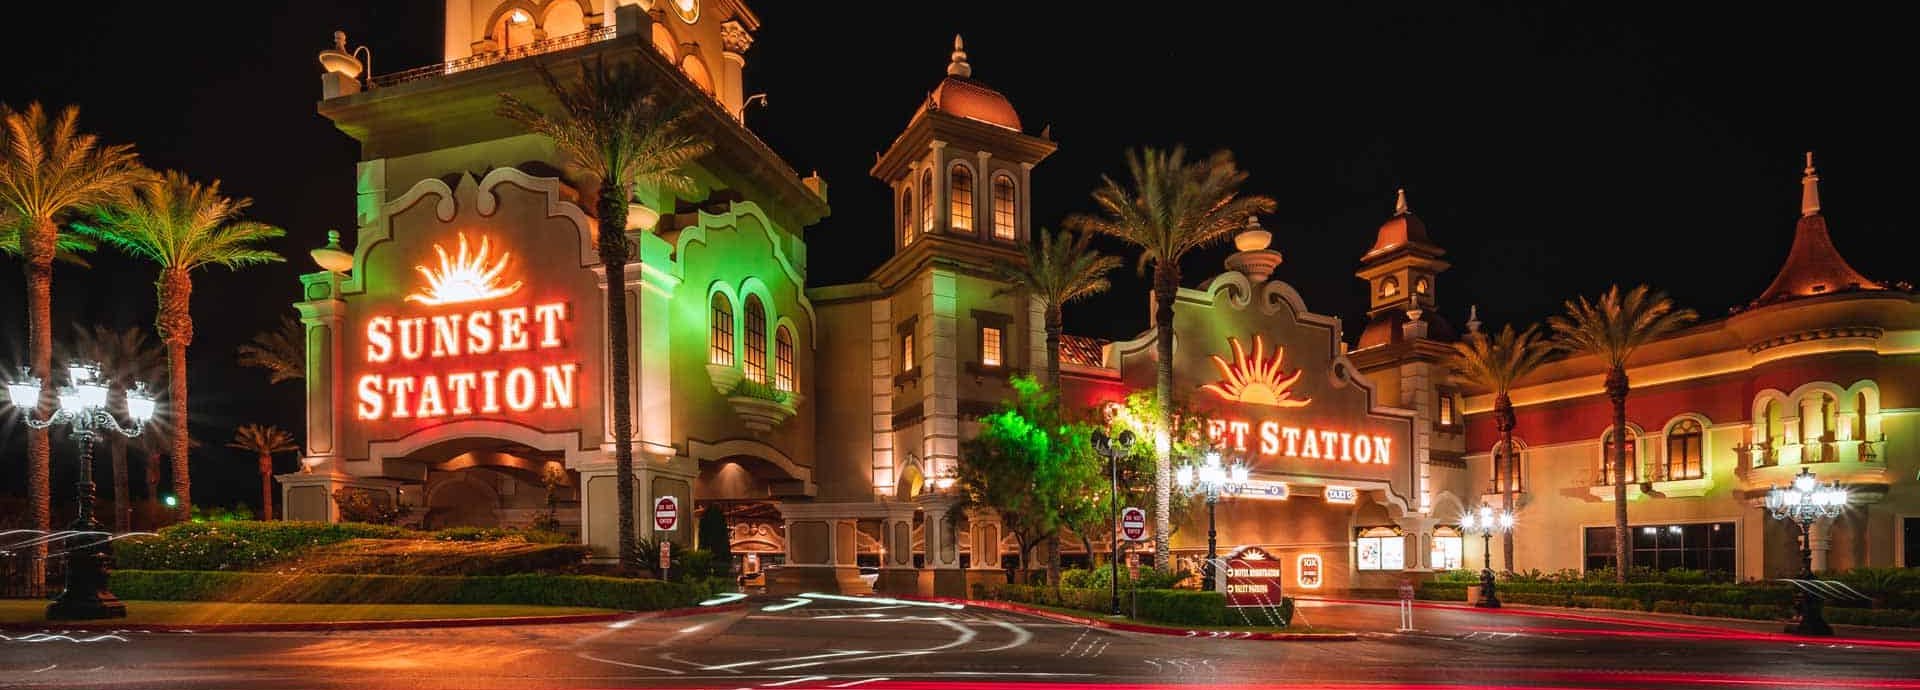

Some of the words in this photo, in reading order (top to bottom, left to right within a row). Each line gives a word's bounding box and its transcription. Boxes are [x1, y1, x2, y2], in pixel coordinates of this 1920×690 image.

[366, 302, 566, 363] SUNSET
[357, 363, 577, 420] STATION
[1260, 420, 1391, 465] STATION
